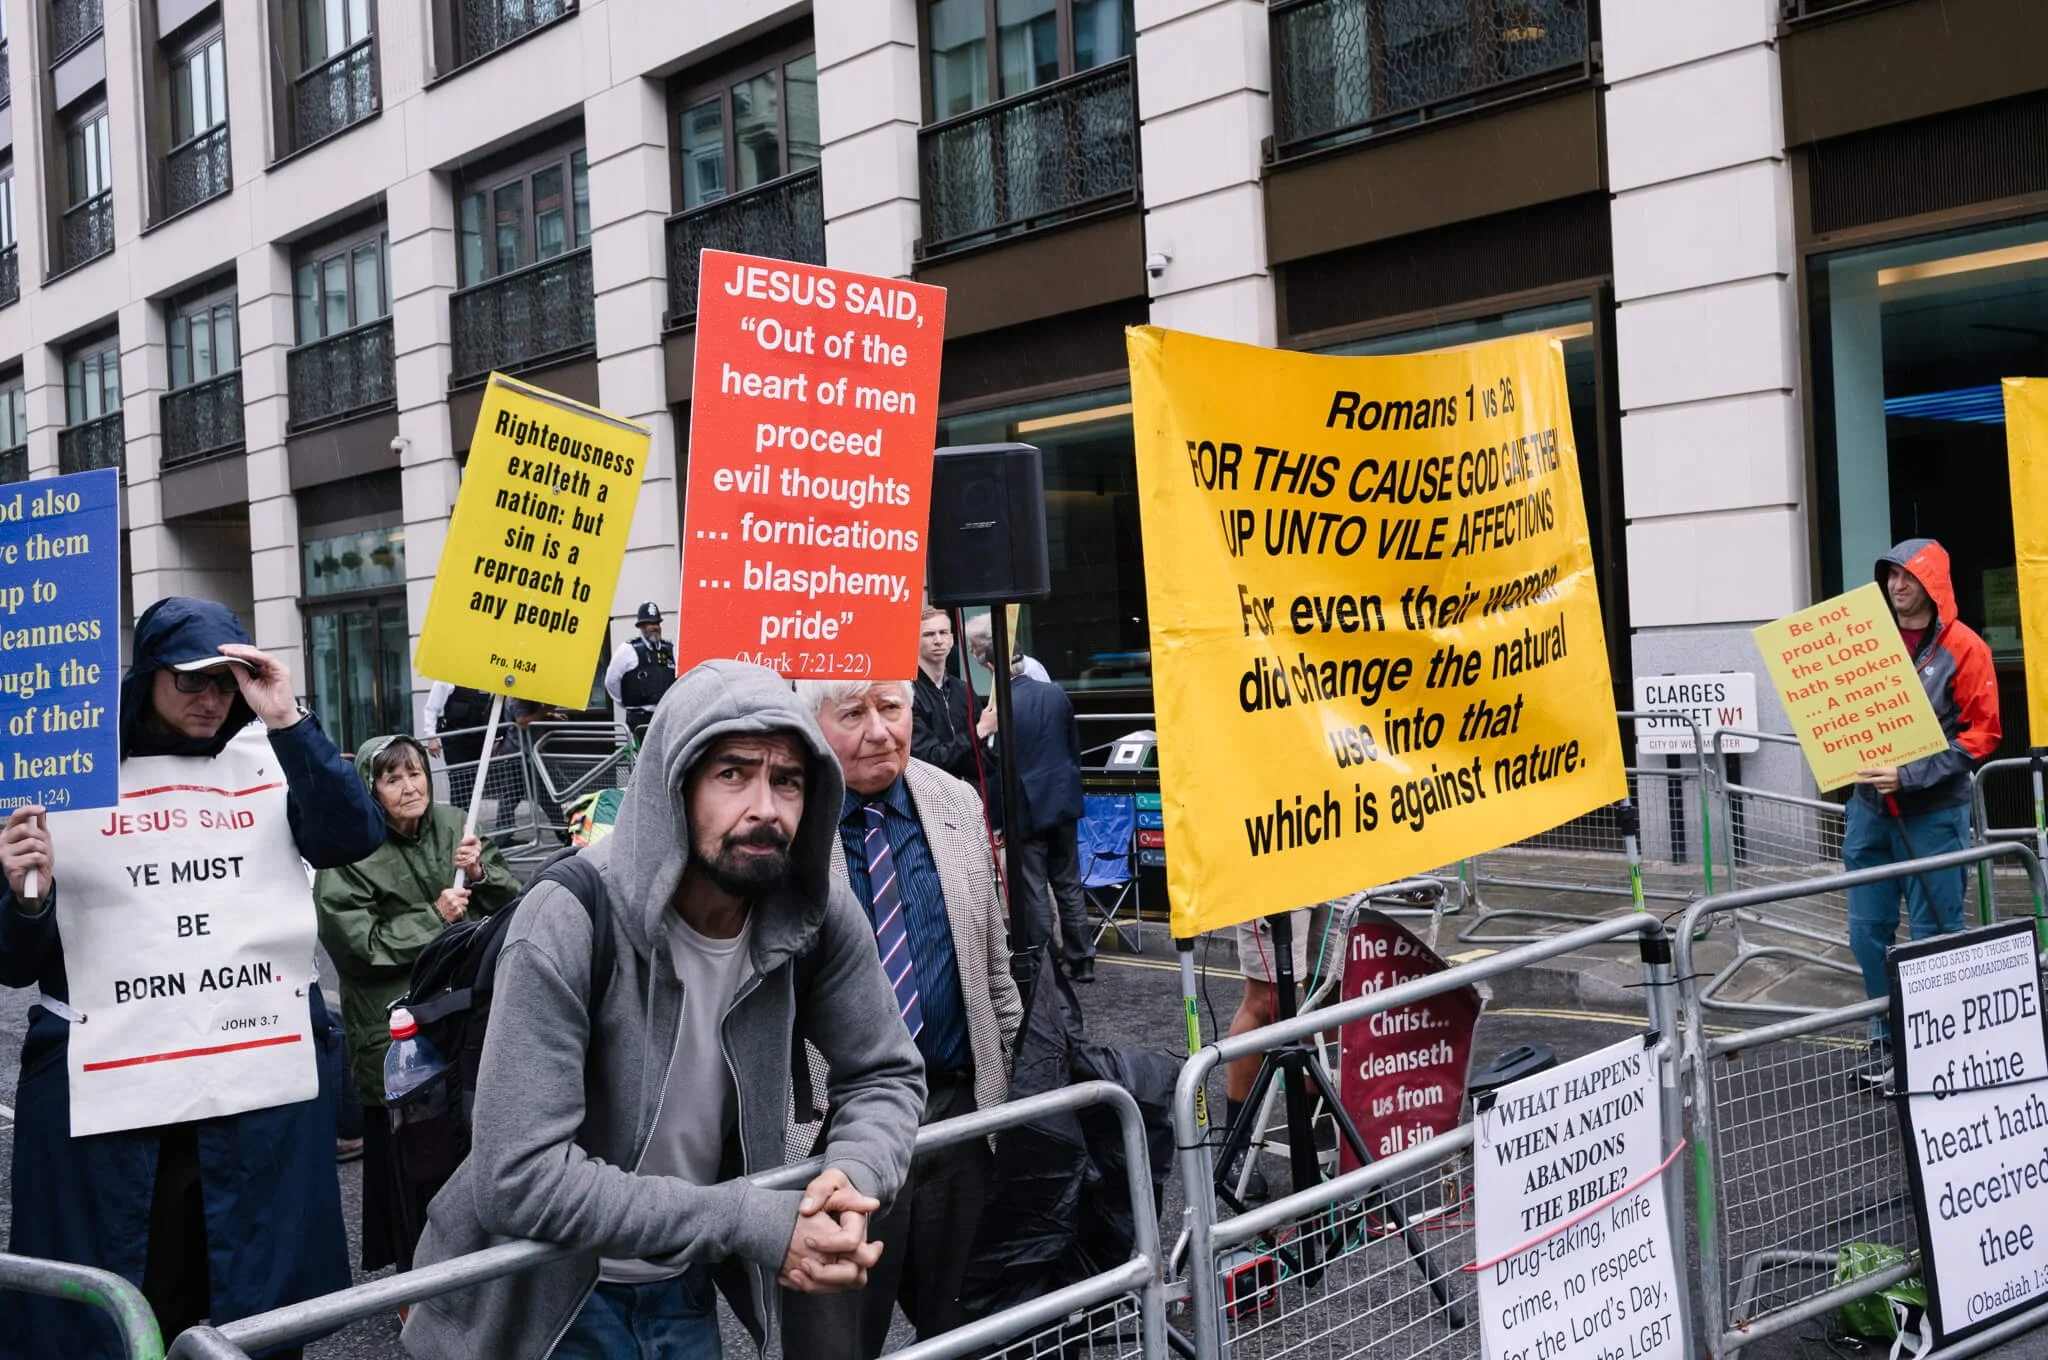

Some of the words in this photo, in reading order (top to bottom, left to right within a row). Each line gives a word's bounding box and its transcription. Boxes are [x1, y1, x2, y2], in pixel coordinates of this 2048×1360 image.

[724, 265, 835, 310] JESUS
[845, 282, 924, 328] SAID,
[740, 316, 815, 356] “Out
[824, 332, 854, 360] of
[861, 334, 908, 368] the
[721, 362, 807, 402] heart
[817, 377, 847, 406] of
[855, 386, 916, 415] men
[1326, 390, 1457, 432] Romans
[1465, 384, 1475, 422] 1
[1481, 392, 1498, 418] vs
[1500, 376, 1515, 413] 26
[495, 410, 634, 477] Righteousness
[755, 422, 882, 457] proceed
[508, 455, 591, 497] exalteth
[597, 484, 608, 503] a
[714, 464, 769, 496] evil
[780, 468, 911, 509] thoughts
[1187, 441, 1242, 492] FOR
[1253, 447, 1340, 498] THIS
[1348, 455, 1452, 503] CAUSE
[1457, 450, 1498, 497] GOD
[1502, 437, 1534, 487] GAVE
[31, 489, 80, 518] also
[495, 488, 565, 526] nation:
[572, 509, 604, 537] but
[1219, 509, 1254, 558] UP
[1265, 508, 1367, 557] UNTO
[1377, 516, 1448, 560] VILE
[1452, 490, 1554, 558] AFFECTIONS
[25, 533, 89, 562] them
[504, 526, 534, 553] sin
[542, 533, 560, 559] is
[568, 545, 580, 565] a
[740, 512, 919, 553] fornications
[33, 578, 57, 603] to
[473, 555, 563, 596] reproach
[572, 575, 591, 603] to
[743, 560, 910, 603] blasphemy,
[1237, 583, 1275, 637] For
[1290, 592, 1385, 635] even
[1399, 581, 1481, 631] their
[1482, 564, 1559, 616] women
[470, 590, 508, 620] any
[514, 602, 579, 634] people
[760, 611, 854, 645] pride”
[1788, 621, 1814, 637] Be
[1819, 605, 1851, 627] not
[0, 618, 101, 650] eanness
[1781, 631, 1843, 664] proud,
[1846, 618, 1874, 637] for
[60, 658, 100, 687] the
[490, 653, 508, 669] Pro.
[513, 658, 537, 674] 14:34
[799, 652, 872, 678] 7:21-22)
[1239, 656, 1291, 714] did
[1292, 651, 1412, 707] change
[1426, 644, 1481, 690] the
[1492, 611, 1567, 680] natural
[1786, 678, 1830, 703] hath
[1834, 652, 1903, 686] spoken
[1792, 661, 1823, 680] the
[1826, 638, 1880, 666] LORD
[1646, 683, 1725, 704] CLARGES
[1827, 697, 1841, 710] A
[1845, 674, 1902, 703] man’s
[9, 707, 37, 736] of
[42, 701, 104, 733] their
[1329, 724, 1377, 769] use
[1384, 707, 1444, 754] into
[1458, 693, 1523, 743] that
[1717, 706, 1743, 727] W1
[1811, 712, 1860, 739] pride
[1864, 691, 1910, 717] shall
[1823, 728, 1874, 754] bring
[1877, 713, 1914, 734] him
[14, 748, 93, 780] hearts
[1649, 740, 1667, 750] CITY
[1669, 740, 1679, 749] OF
[1858, 742, 1893, 762] low
[38, 787, 70, 808] 1:24)
[1246, 788, 1342, 857] which
[1355, 782, 1378, 833] is
[1390, 756, 1485, 832] against
[1495, 740, 1586, 795] nature.
[101, 807, 188, 836] JESUS
[200, 810, 255, 831] SAID
[126, 862, 160, 888] YE
[171, 856, 244, 884] MUST
[177, 914, 211, 937] BE
[1900, 961, 1926, 977] WHAT
[1928, 955, 1949, 971] GOD
[1950, 948, 1971, 965] SAYS
[1971, 947, 1984, 960] TO
[1984, 940, 2011, 956] THOSE
[2011, 935, 2032, 949] WHO
[1908, 975, 1942, 995] IGNORE
[1943, 971, 1957, 985] HIS
[1958, 953, 2029, 981] COMMANDMENTS
[115, 973, 186, 1004] BORN
[199, 961, 282, 993] AGAIN.
[1361, 971, 1385, 997] of
[221, 1018, 256, 1031] JOHN
[260, 1015, 279, 1026] 3.7
[1369, 1007, 1449, 1038] Christ...
[1908, 1009, 1956, 1049] The
[1962, 982, 2037, 1034] PRIDE
[1360, 1040, 1453, 1081] cleanseth
[1933, 1060, 1959, 1100] of
[1962, 1049, 2024, 1088] thine
[1372, 1096, 1393, 1118] us
[1397, 1084, 1443, 1113] from
[1498, 1085, 1559, 1128] WHAT
[1563, 1053, 1641, 1103] HAPPENS
[1379, 1125, 1402, 1156] all
[1495, 1123, 1559, 1167] WHEN
[1563, 1120, 1576, 1141] A
[1579, 1087, 1645, 1137] NATION
[1921, 1112, 1993, 1165] heart
[1994, 1093, 2048, 1140] hath
[1524, 1133, 1625, 1195] ABANDONS
[1521, 1197, 1563, 1233] THE
[1567, 1166, 1628, 1221] BIBLE?
[1495, 1219, 1607, 1286] Drug-taking,
[1611, 1196, 1651, 1229] knife
[1979, 1224, 2034, 1267] thee
[1502, 1289, 1559, 1330] crime,
[1563, 1277, 1586, 1301] no
[1591, 1238, 1656, 1286] respect
[1967, 1275, 2031, 1322] (Obadiah
[1535, 1330, 1567, 1360] the
[1571, 1297, 1626, 1344] Lord’s
[1629, 1281, 1668, 1313] Day,
[1629, 1314, 1672, 1359] LGBT
